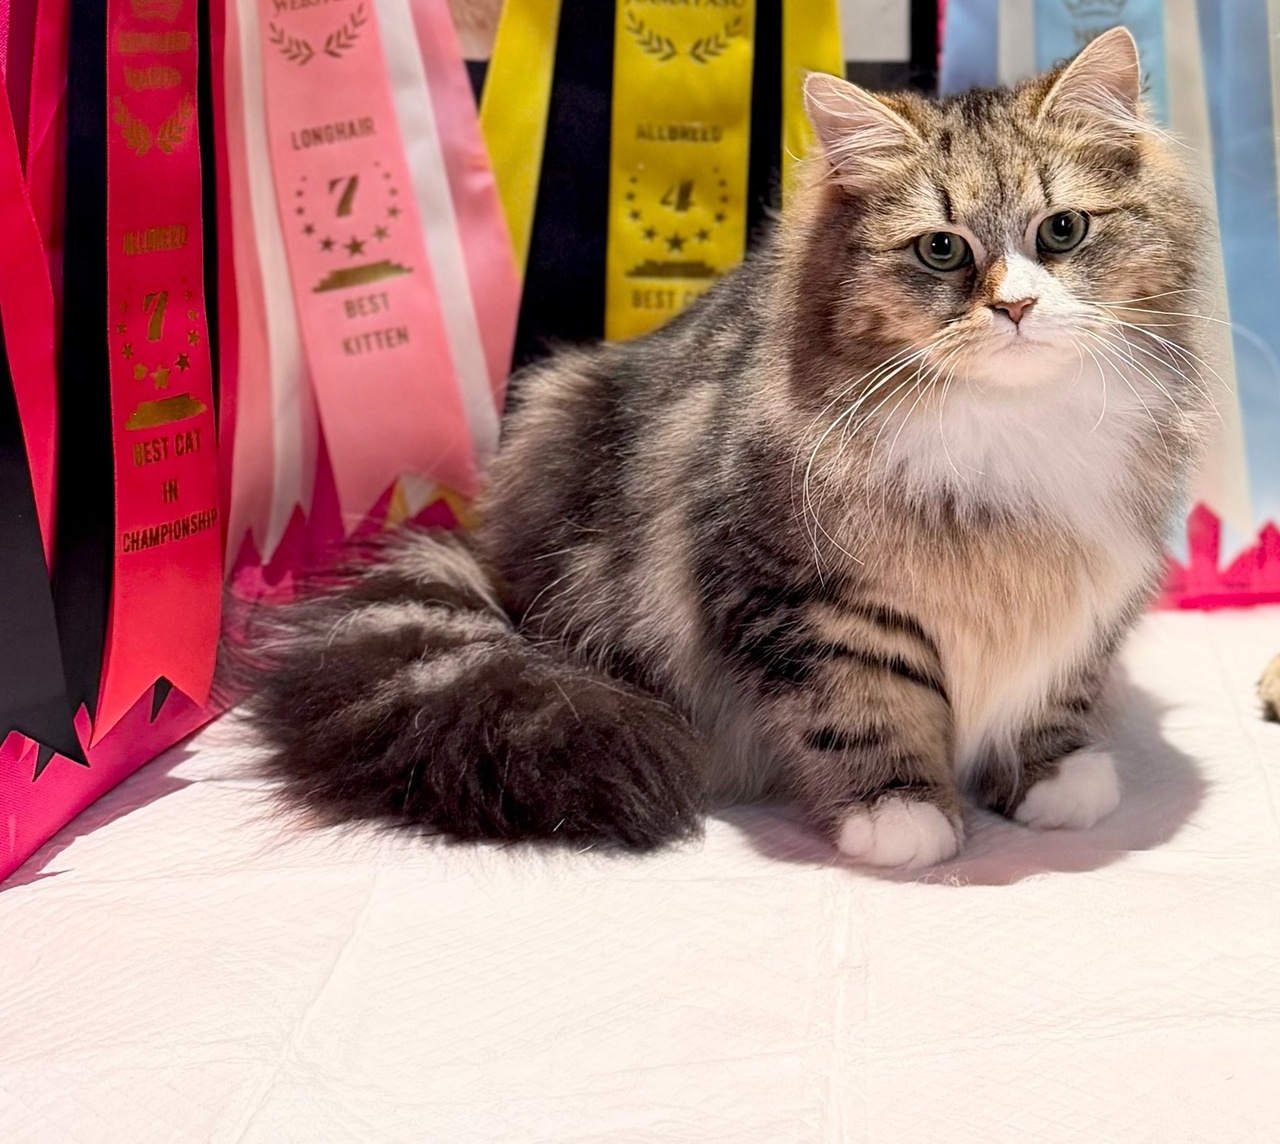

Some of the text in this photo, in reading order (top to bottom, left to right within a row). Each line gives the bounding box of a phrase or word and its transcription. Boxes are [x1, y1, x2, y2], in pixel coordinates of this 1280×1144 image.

[291, 117, 376, 151] LONGHAIR
[328, 174, 359, 218] 7
[659, 178, 695, 213] 4
[143, 290, 168, 342] 7
[344, 292, 391, 319] BEST
[342, 326, 410, 356] KITTEN
[133, 429, 203, 467] BEST CAT
[162, 479, 179, 504] IN
[123, 508, 218, 554] CHAMPIONSHIP
